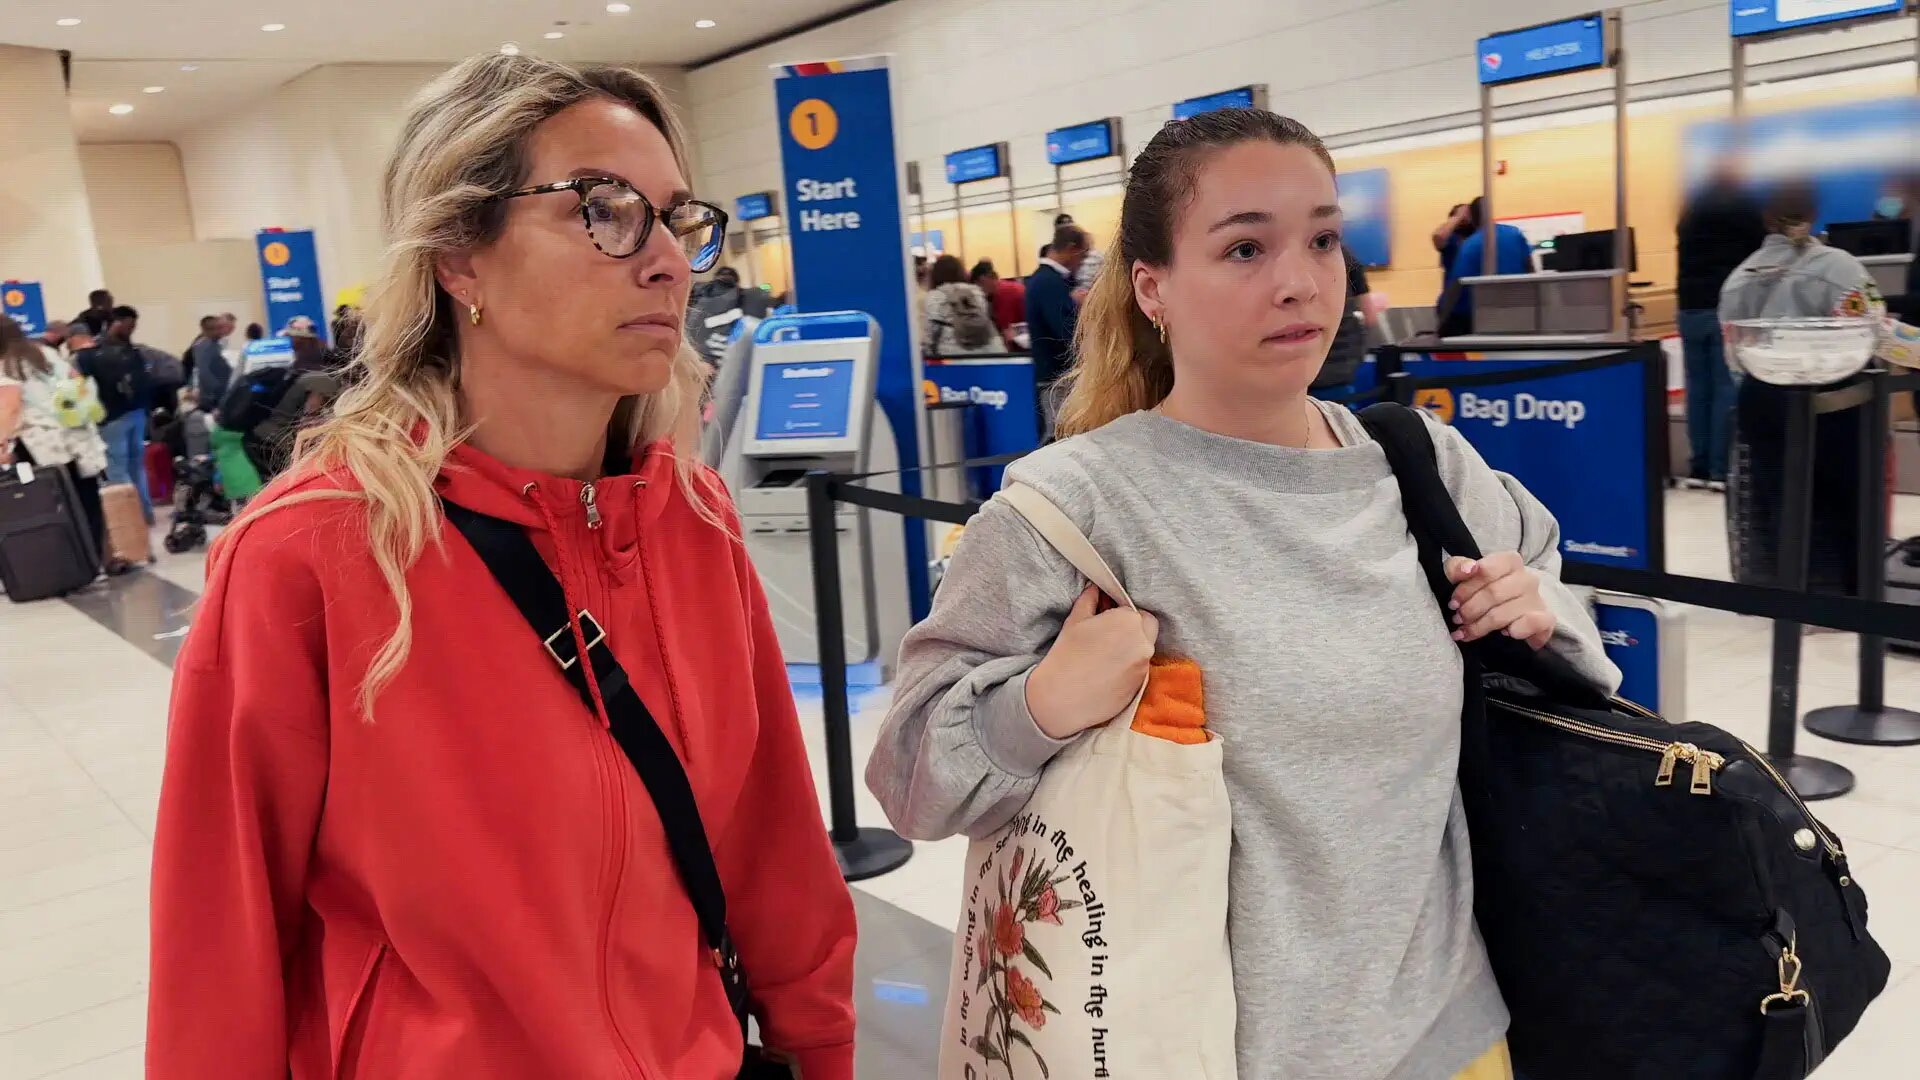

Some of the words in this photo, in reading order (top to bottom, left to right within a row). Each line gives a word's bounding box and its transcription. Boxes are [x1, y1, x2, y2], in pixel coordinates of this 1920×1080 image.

[796, 177, 858, 202] Start
[800, 209, 860, 232] Here
[1460, 392, 1509, 427] Bag
[1514, 393, 1585, 429] Drop
[1032, 815, 1047, 837] in
[1050, 829, 1074, 863] the
[1072, 861, 1108, 948] healing
[1091, 955, 1109, 976] in
[1084, 984, 1108, 1018] the
